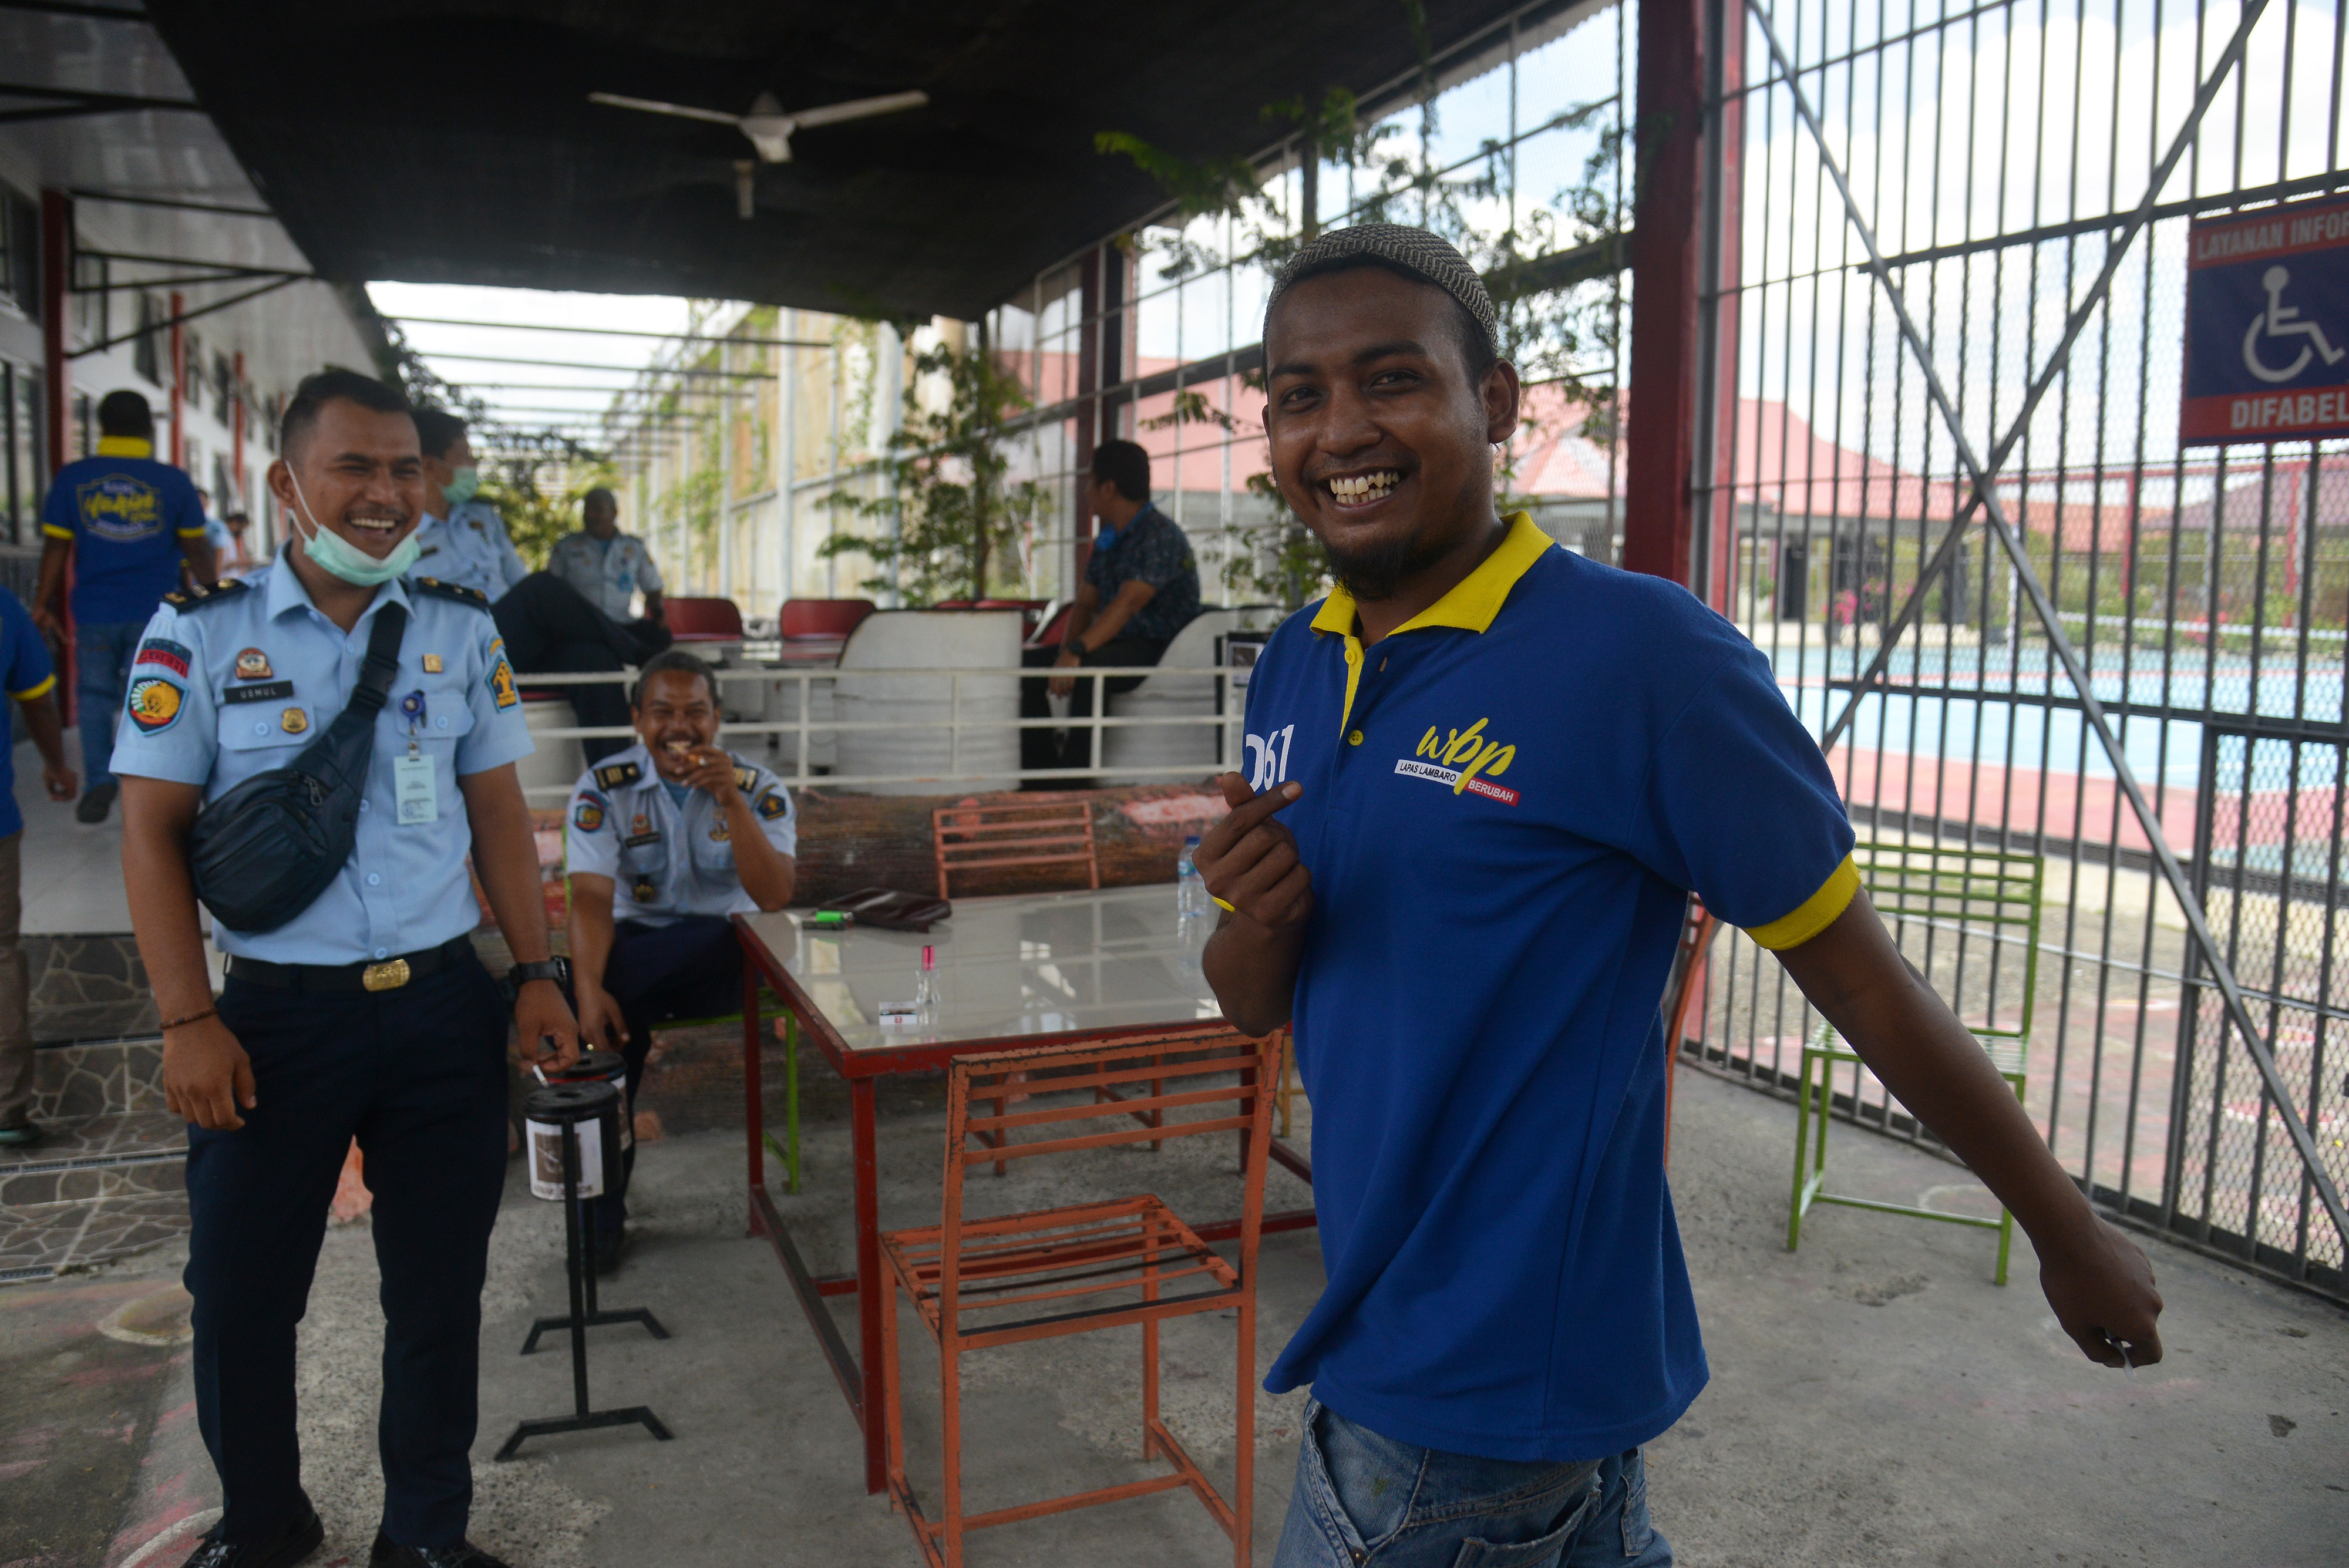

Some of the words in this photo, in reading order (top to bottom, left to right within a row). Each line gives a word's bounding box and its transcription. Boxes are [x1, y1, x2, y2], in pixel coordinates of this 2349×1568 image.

[2197, 221, 2284, 260] LAYANAN
[2232, 392, 2349, 429] DIFABEL
[1399, 763, 1418, 773] LAPAS
[1419, 766, 1456, 782] LAMBARO
[1416, 717, 1516, 795] wbp
[1468, 780, 1513, 802] BERUBAH
